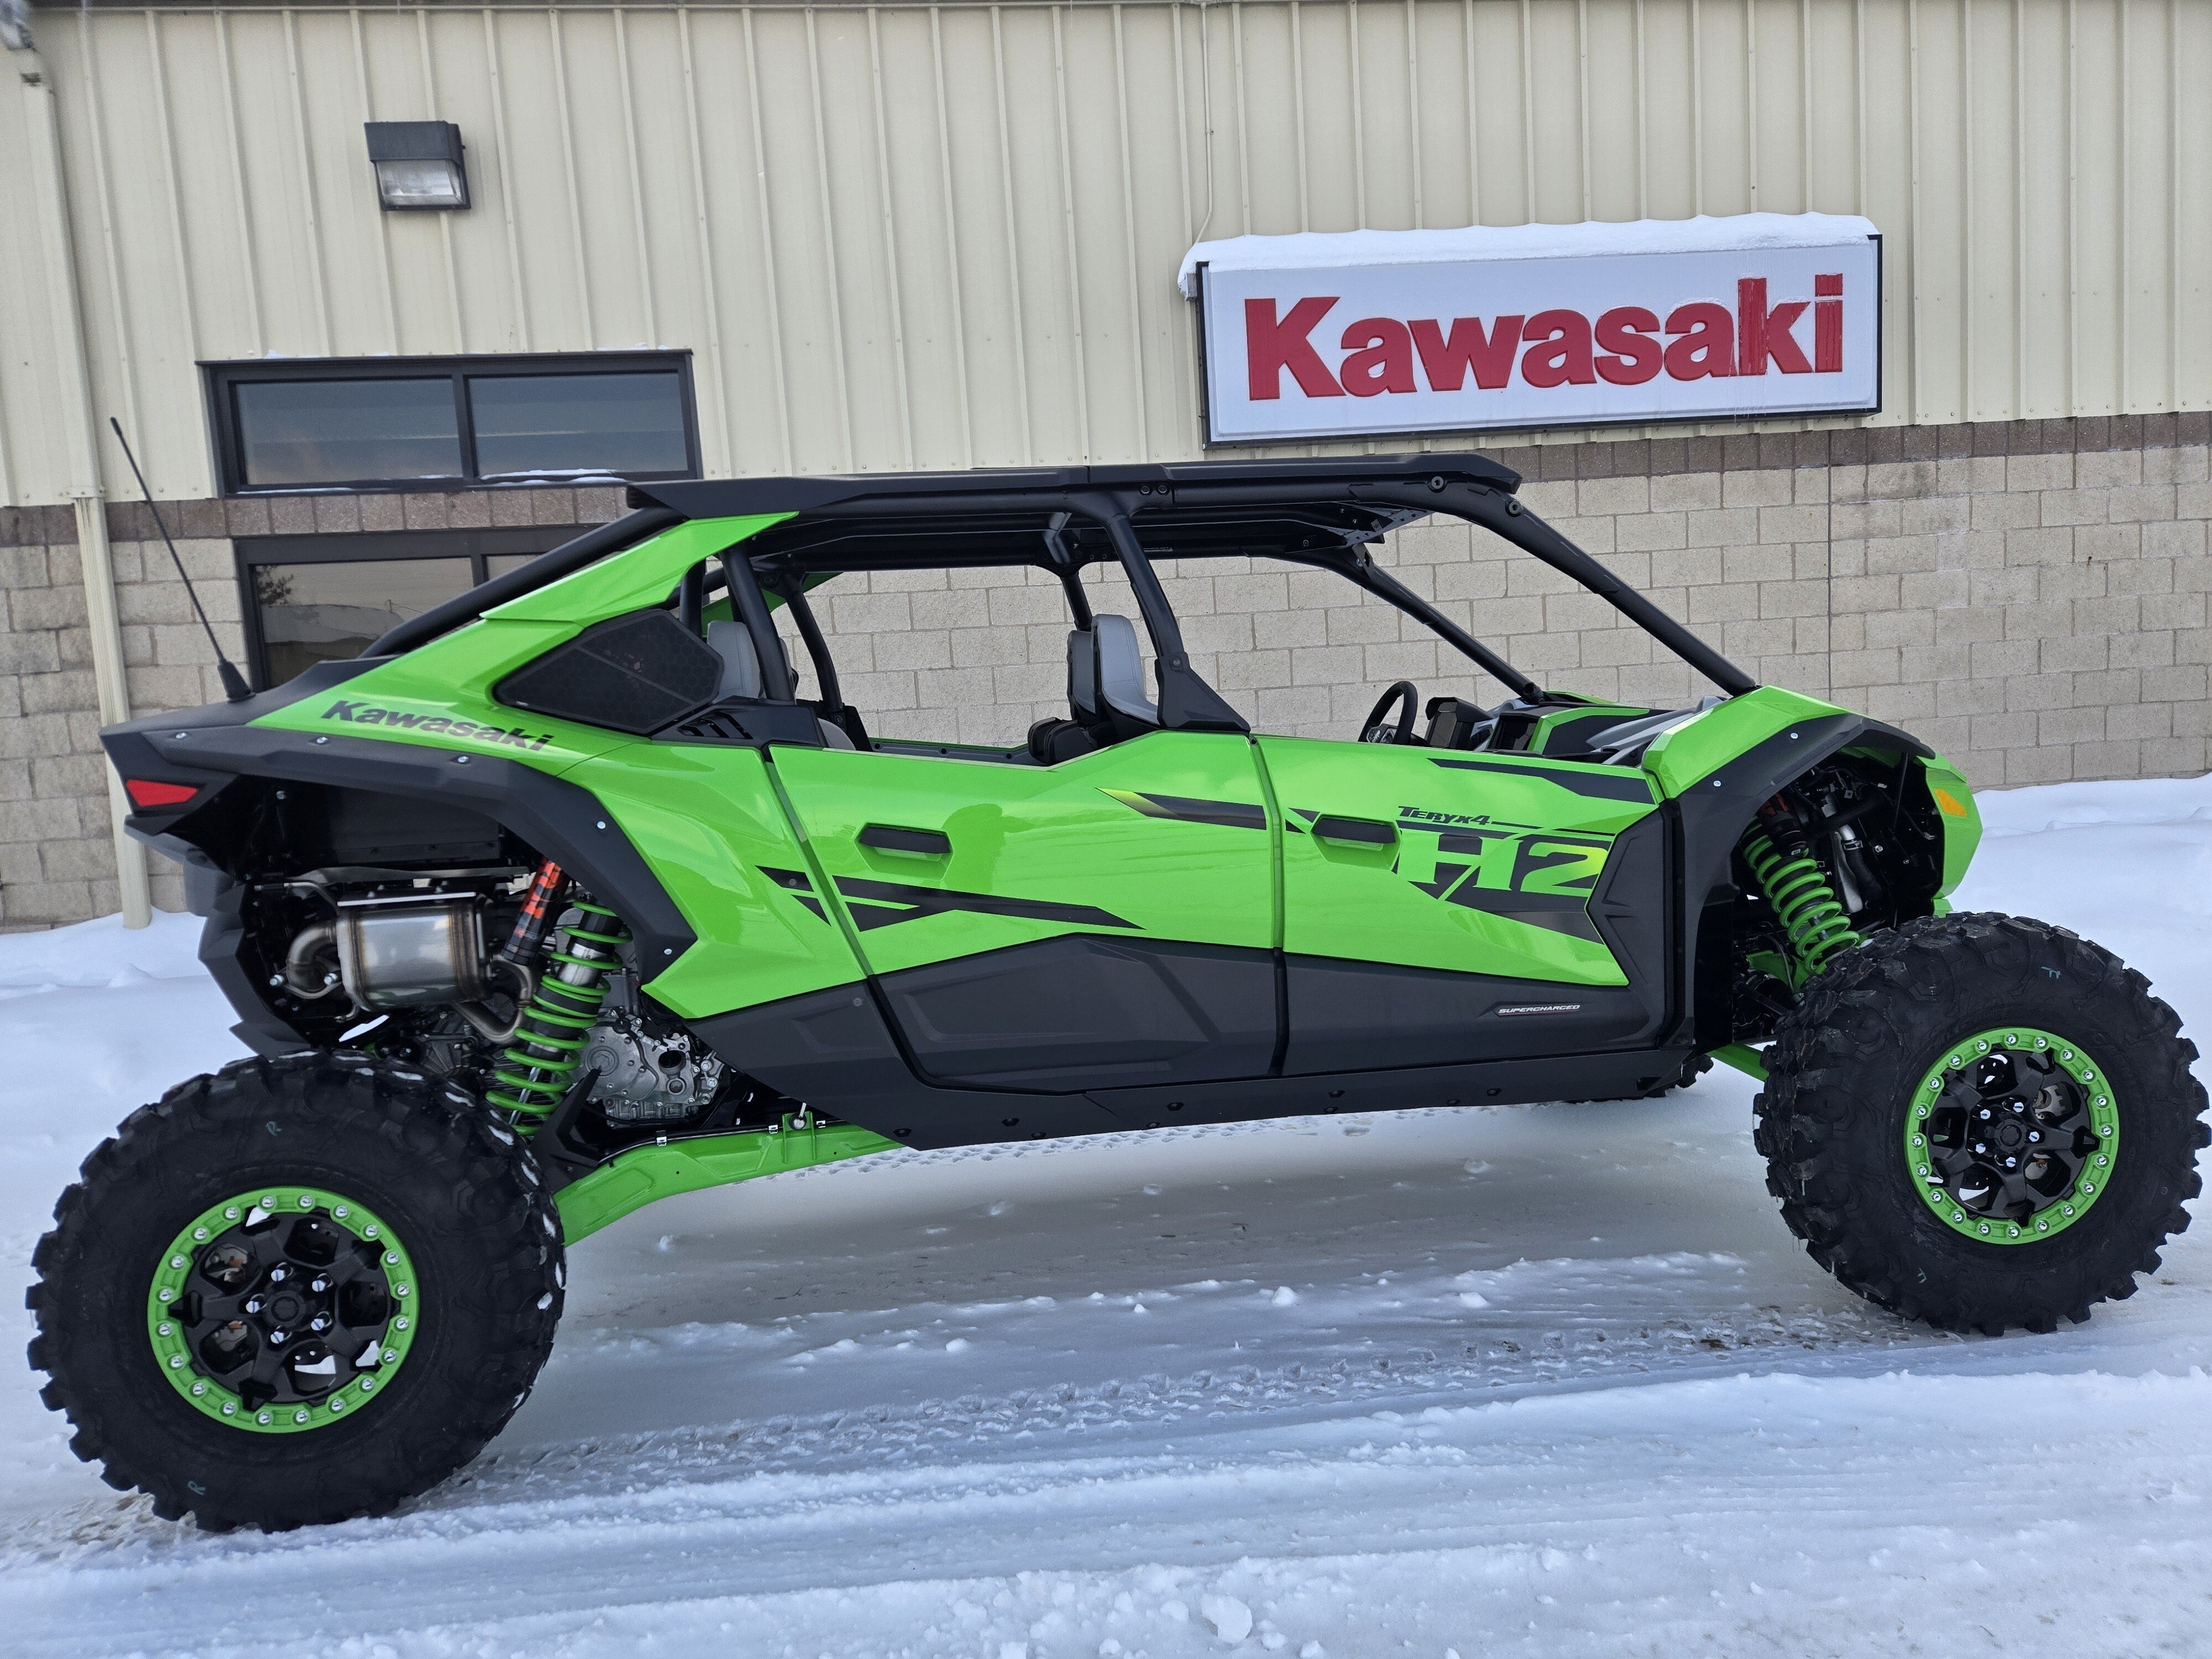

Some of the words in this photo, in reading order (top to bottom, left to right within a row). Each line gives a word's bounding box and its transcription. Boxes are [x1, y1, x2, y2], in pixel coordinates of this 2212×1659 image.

[1244, 273, 1844, 400] Kawasaki
[321, 700, 554, 751] Kawasaki
[1396, 829, 1608, 898] H2
[1499, 1005, 1580, 1014] SUPERCHARGED
